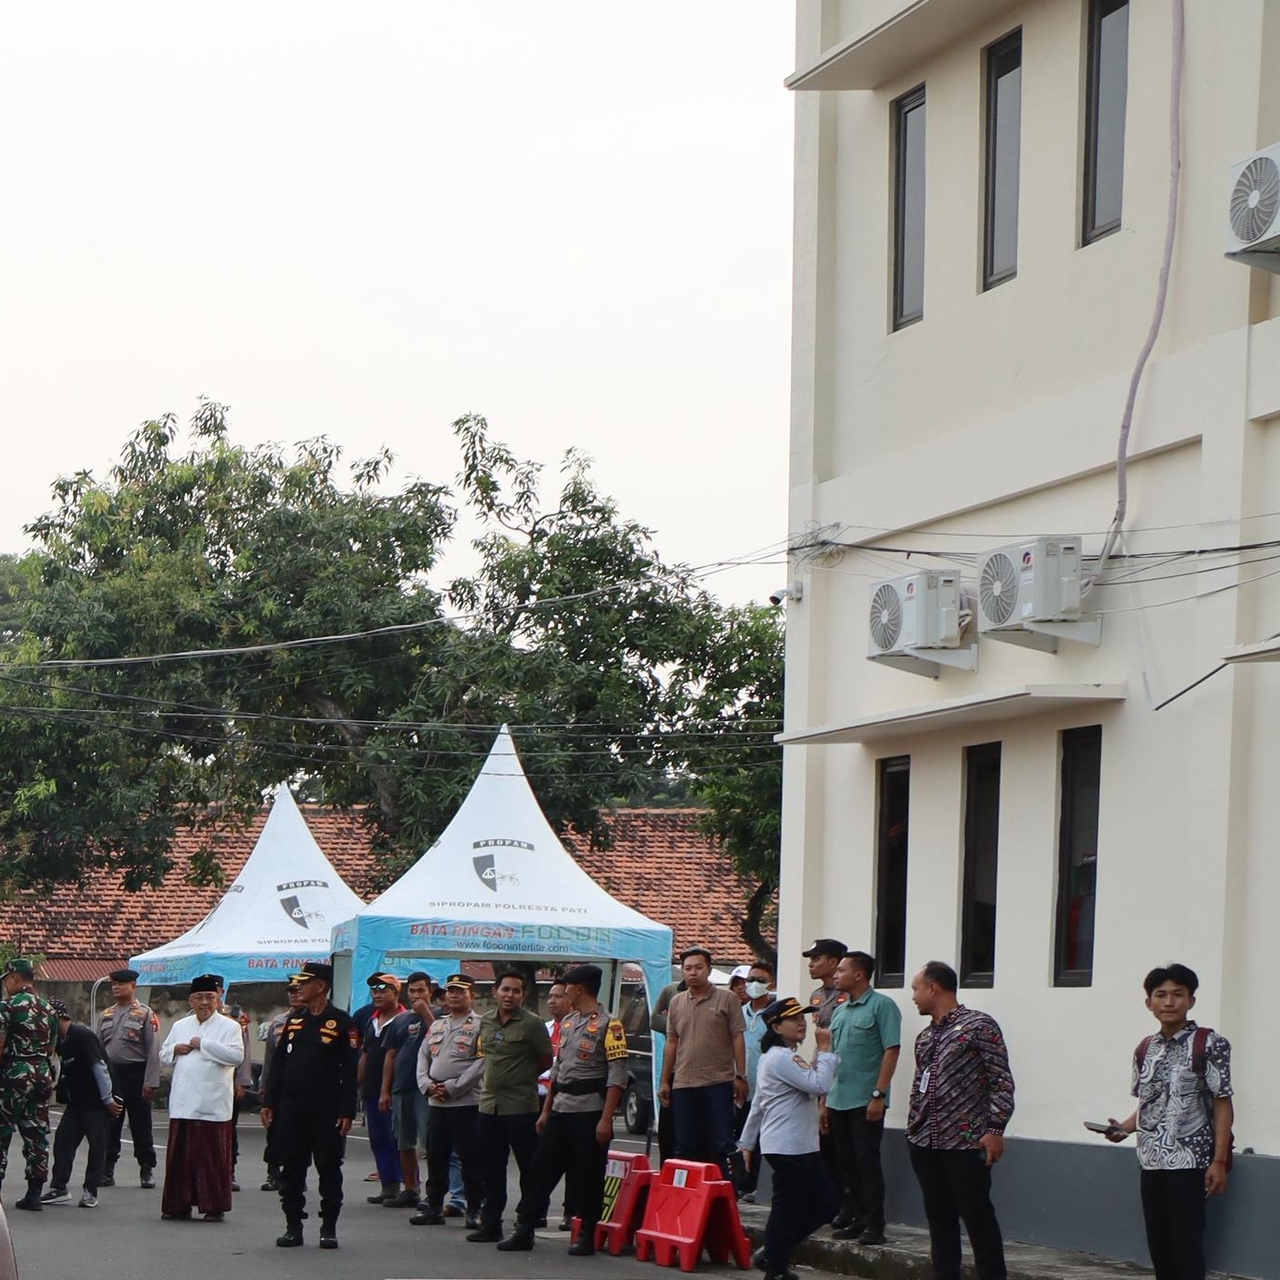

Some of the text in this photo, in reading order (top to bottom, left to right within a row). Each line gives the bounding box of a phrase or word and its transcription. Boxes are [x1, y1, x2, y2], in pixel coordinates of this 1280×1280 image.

[480, 838, 530, 849] PROPAM
[282, 881, 324, 889] PROPAM
[428, 901, 492, 909] SIPROPAM
[495, 903, 558, 912] POLRESTA
[410, 923, 612, 943] BATA RINGAN FOCON
[256, 938, 308, 946] SIPROPAM
[456, 940, 569, 953] www.foconinterlite.com
[247, 958, 280, 969] BATA
